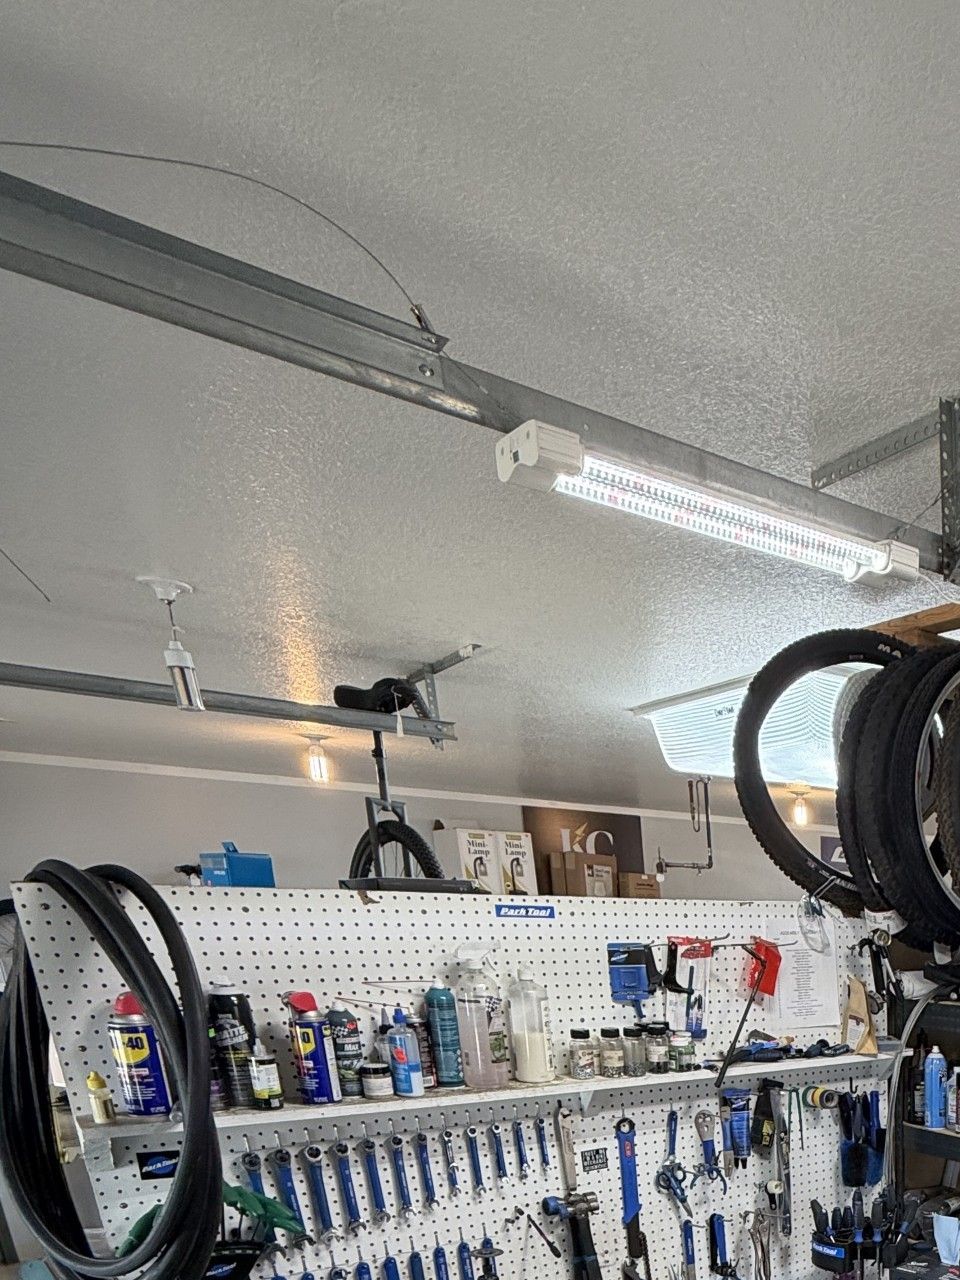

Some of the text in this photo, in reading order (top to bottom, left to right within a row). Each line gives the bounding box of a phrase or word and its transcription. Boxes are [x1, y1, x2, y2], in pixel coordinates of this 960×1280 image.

[466, 839, 489, 849] Mini-
[504, 840, 526, 850] Mini-
[467, 847, 490, 858] Lamp
[505, 848, 527, 859] Lamp
